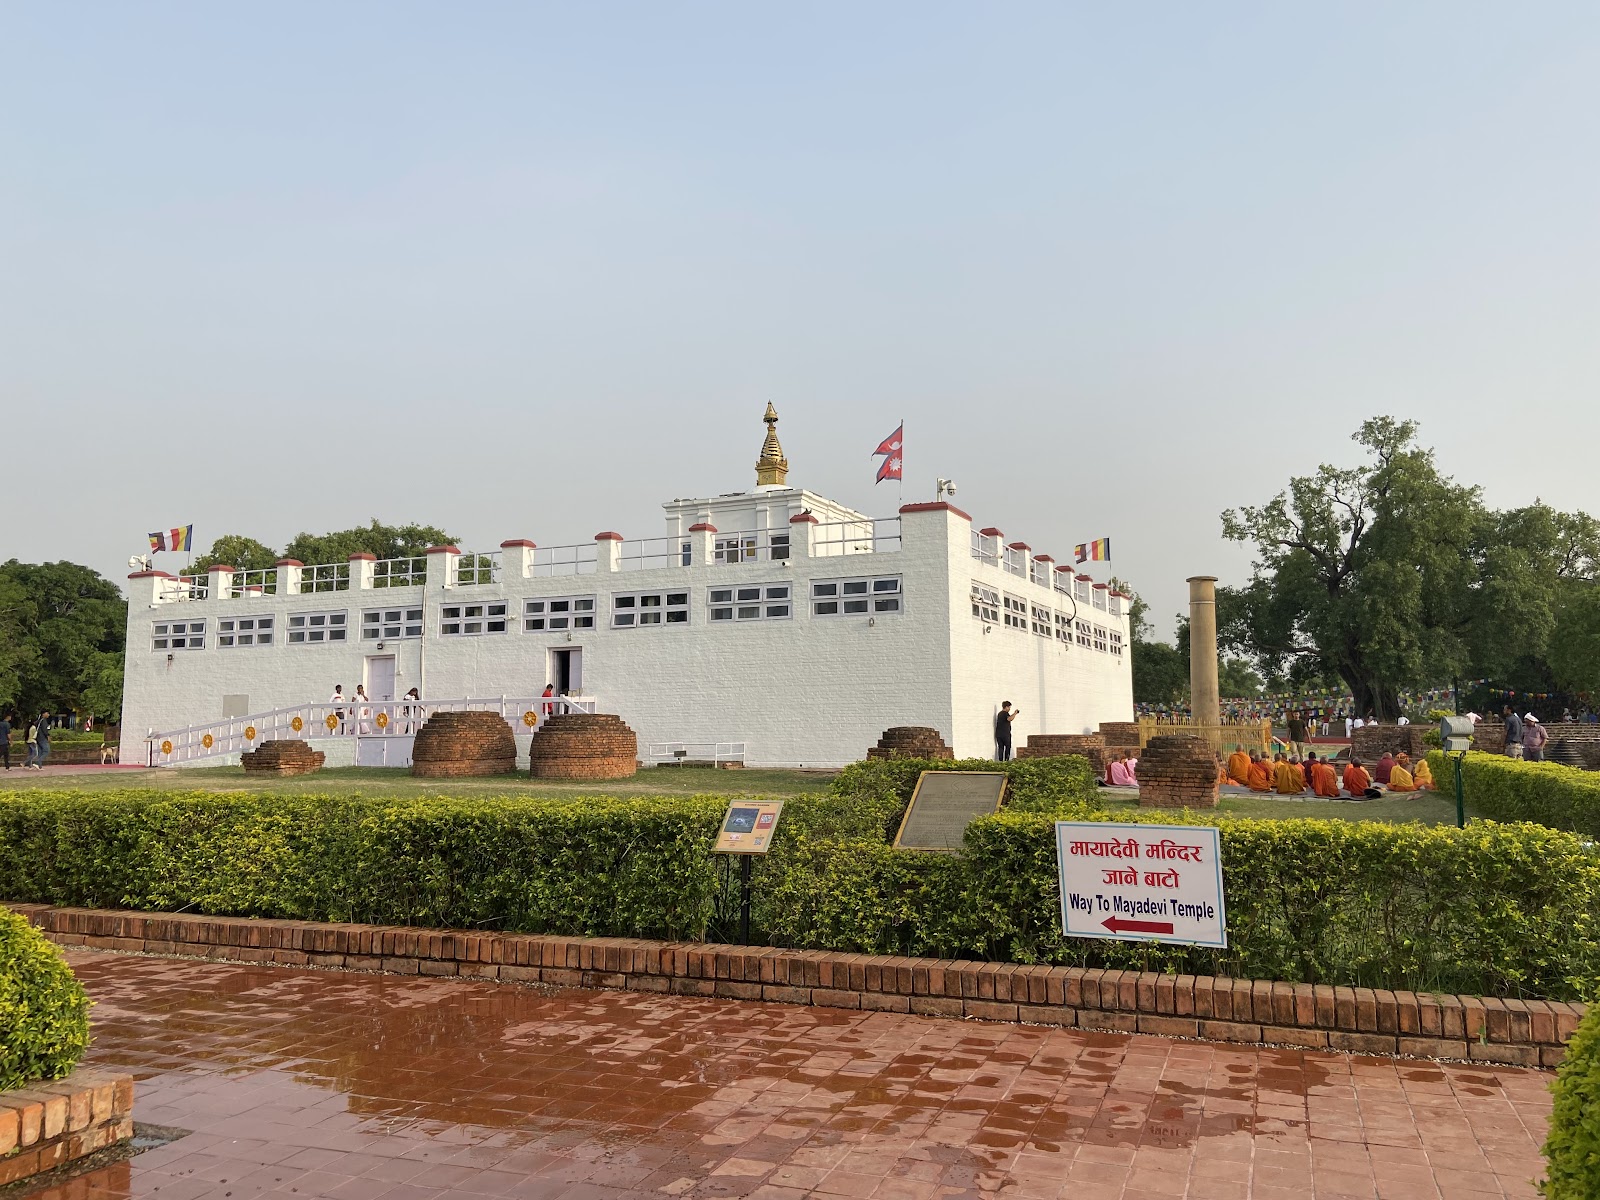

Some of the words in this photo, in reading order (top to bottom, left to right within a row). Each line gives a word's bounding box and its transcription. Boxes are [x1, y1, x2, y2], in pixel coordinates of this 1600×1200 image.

[1070, 838, 1139, 859] मायादेवी
[1145, 839, 1203, 862] मन्दिर
[1101, 866, 1138, 886] जाने
[1144, 868, 1180, 888] बाटो
[1069, 893, 1093, 914] Way
[1096, 895, 1110, 911] To
[1113, 895, 1167, 917] Mayadevi
[1170, 899, 1215, 921] Temple
